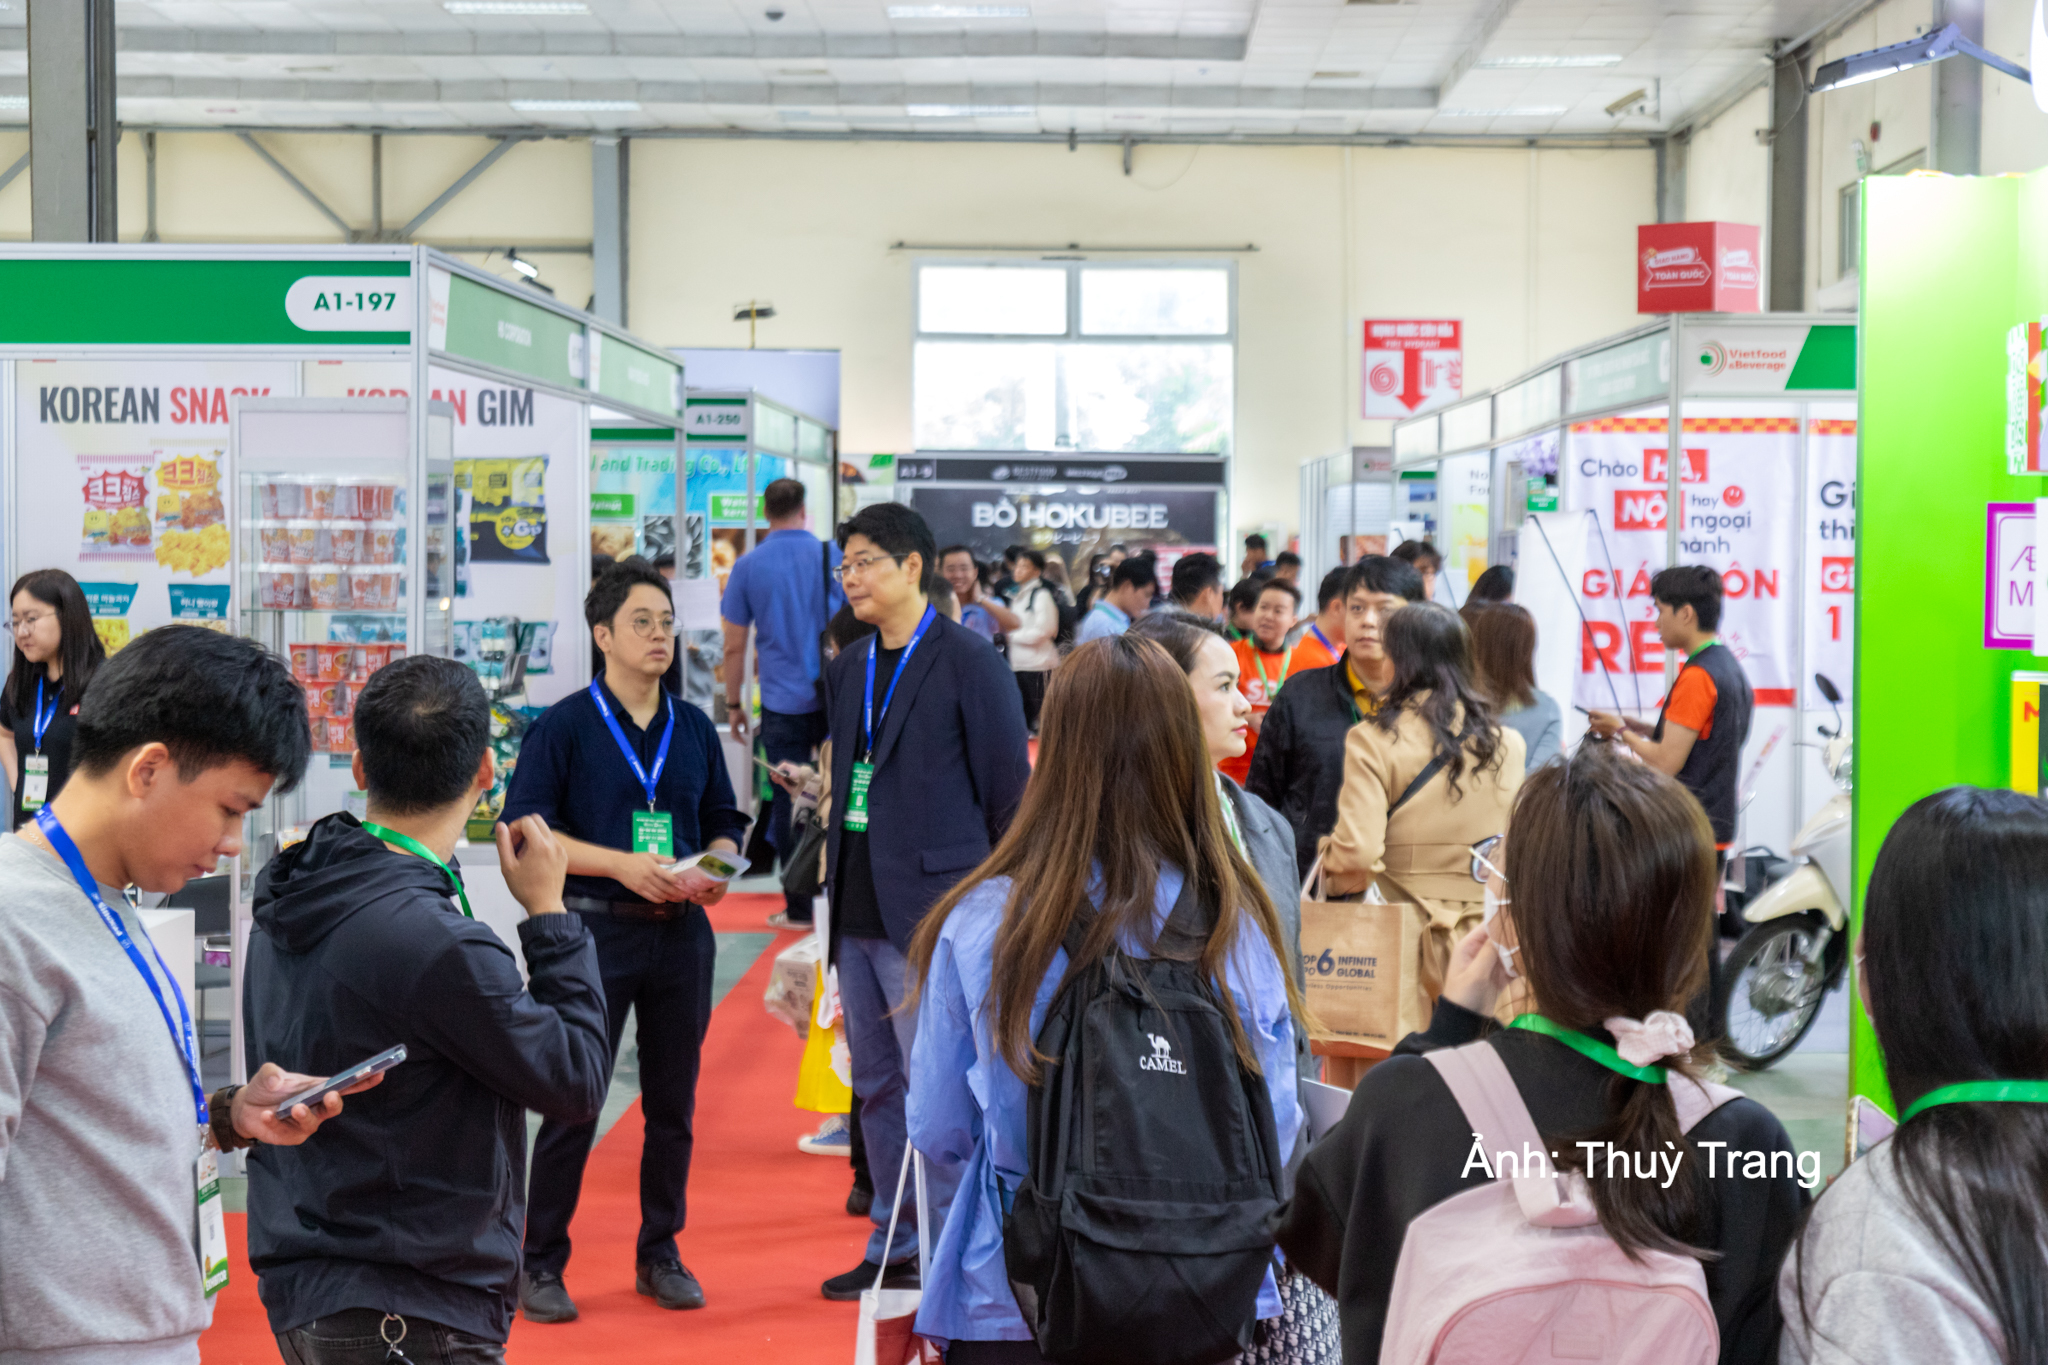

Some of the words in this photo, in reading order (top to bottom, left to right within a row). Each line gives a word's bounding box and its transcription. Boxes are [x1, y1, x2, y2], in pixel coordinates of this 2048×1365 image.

[313, 292, 397, 311] A1-197
[1729, 349, 1787, 359] Vietfood
[40, 386, 160, 424] KOREAN
[169, 386, 271, 424] SNA
[477, 388, 534, 427] GIM
[696, 414, 741, 425] A1-250
[600, 455, 631, 473] and
[1580, 458, 1638, 478] Chào
[1020, 502, 1169, 530] HOKUBEE
[1622, 493, 1668, 528] NỘ
[1692, 493, 1720, 511] hay
[1691, 512, 1752, 534] ngoại
[1680, 536, 1730, 554] ành
[1582, 560, 1652, 599] GIÁ
[1303, 954, 1318, 965] OP
[1316, 948, 1337, 977] 6
[1337, 955, 1378, 967] INFINITE
[1336, 967, 1377, 979] GLOBAL
[1139, 1055, 1187, 1075] CAMEL
